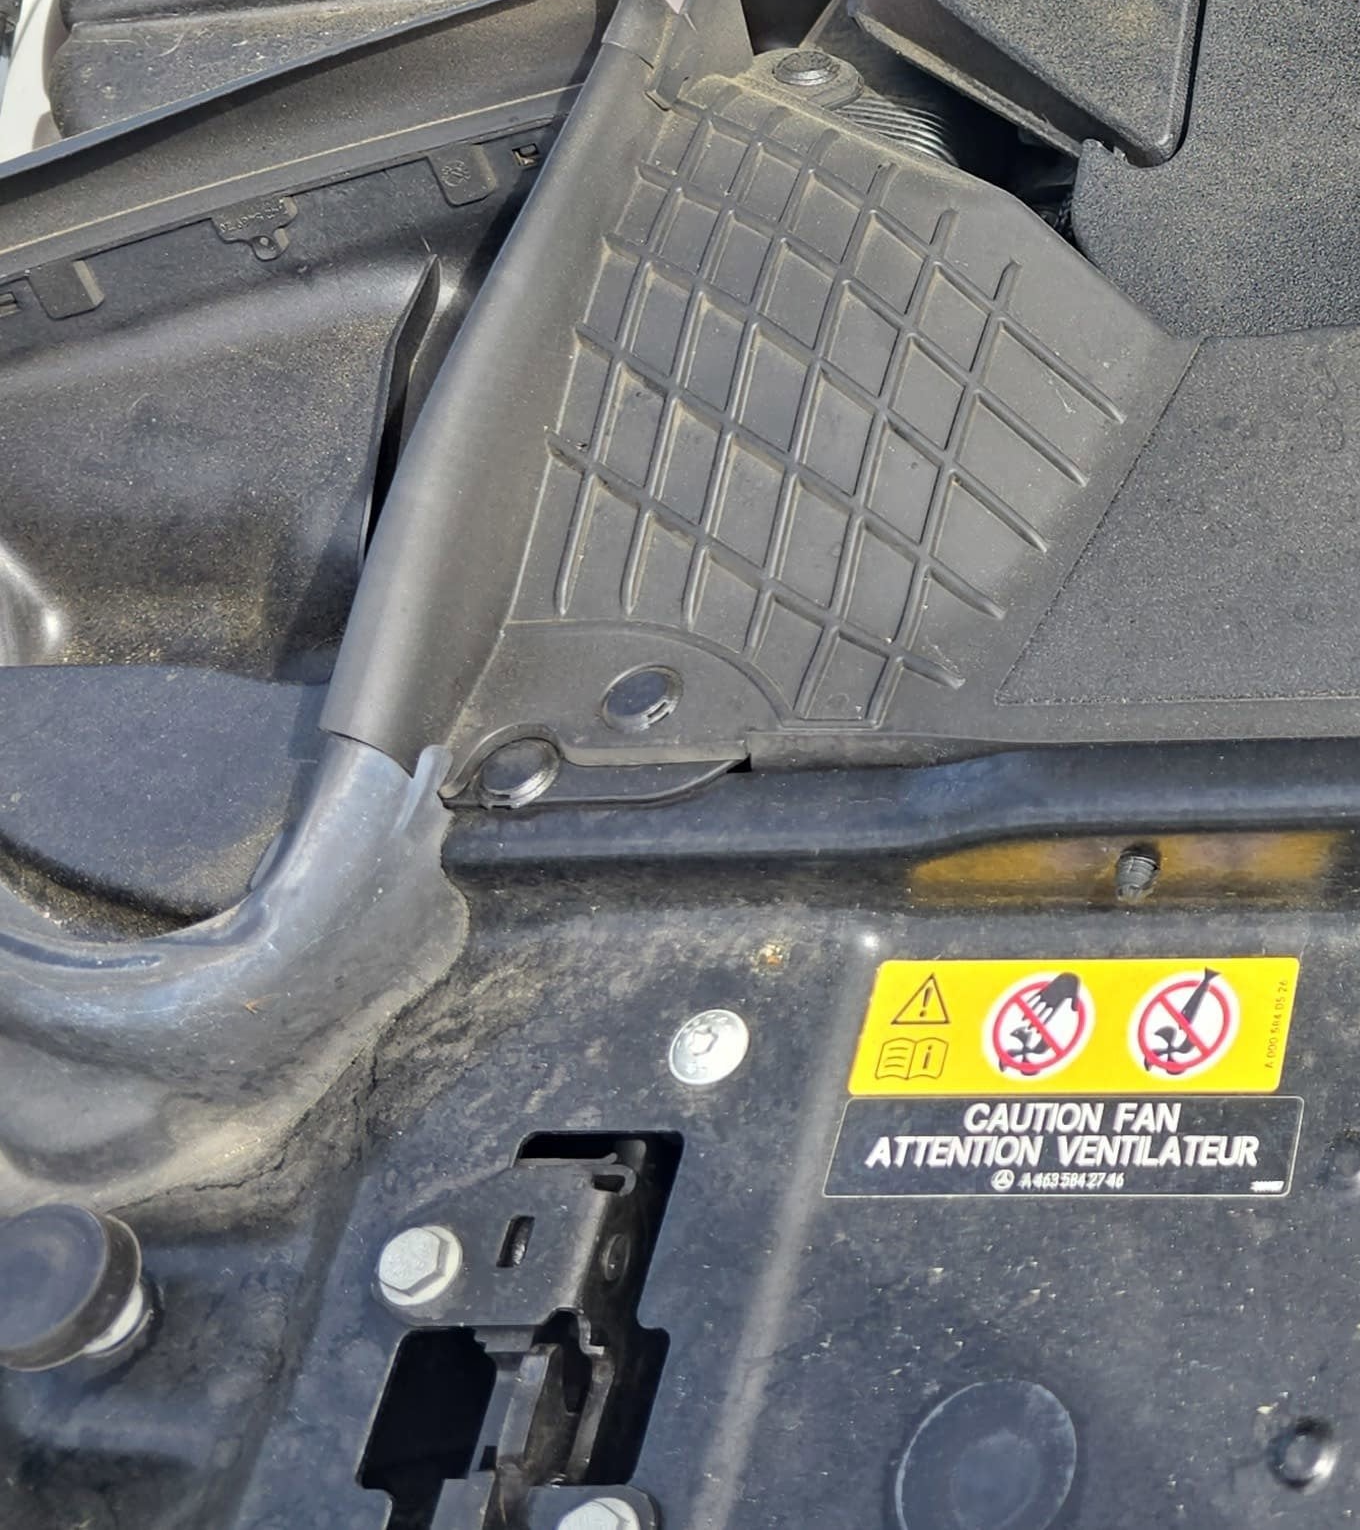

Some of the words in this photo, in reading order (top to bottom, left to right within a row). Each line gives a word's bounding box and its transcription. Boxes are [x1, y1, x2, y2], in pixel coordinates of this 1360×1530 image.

[963, 1102, 1105, 1134] CAUTION
[1112, 1102, 1182, 1134] FAN
[864, 1134, 1045, 1168] ATTENTION
[1057, 1134, 1260, 1167] VENTILATEUR
[1017, 1172, 1031, 1189] A
[1031, 1172, 1060, 1190] 463
[1059, 1172, 1087, 1190] 584
[1086, 1172, 1107, 1190] 27
[1105, 1172, 1125, 1190] 46
